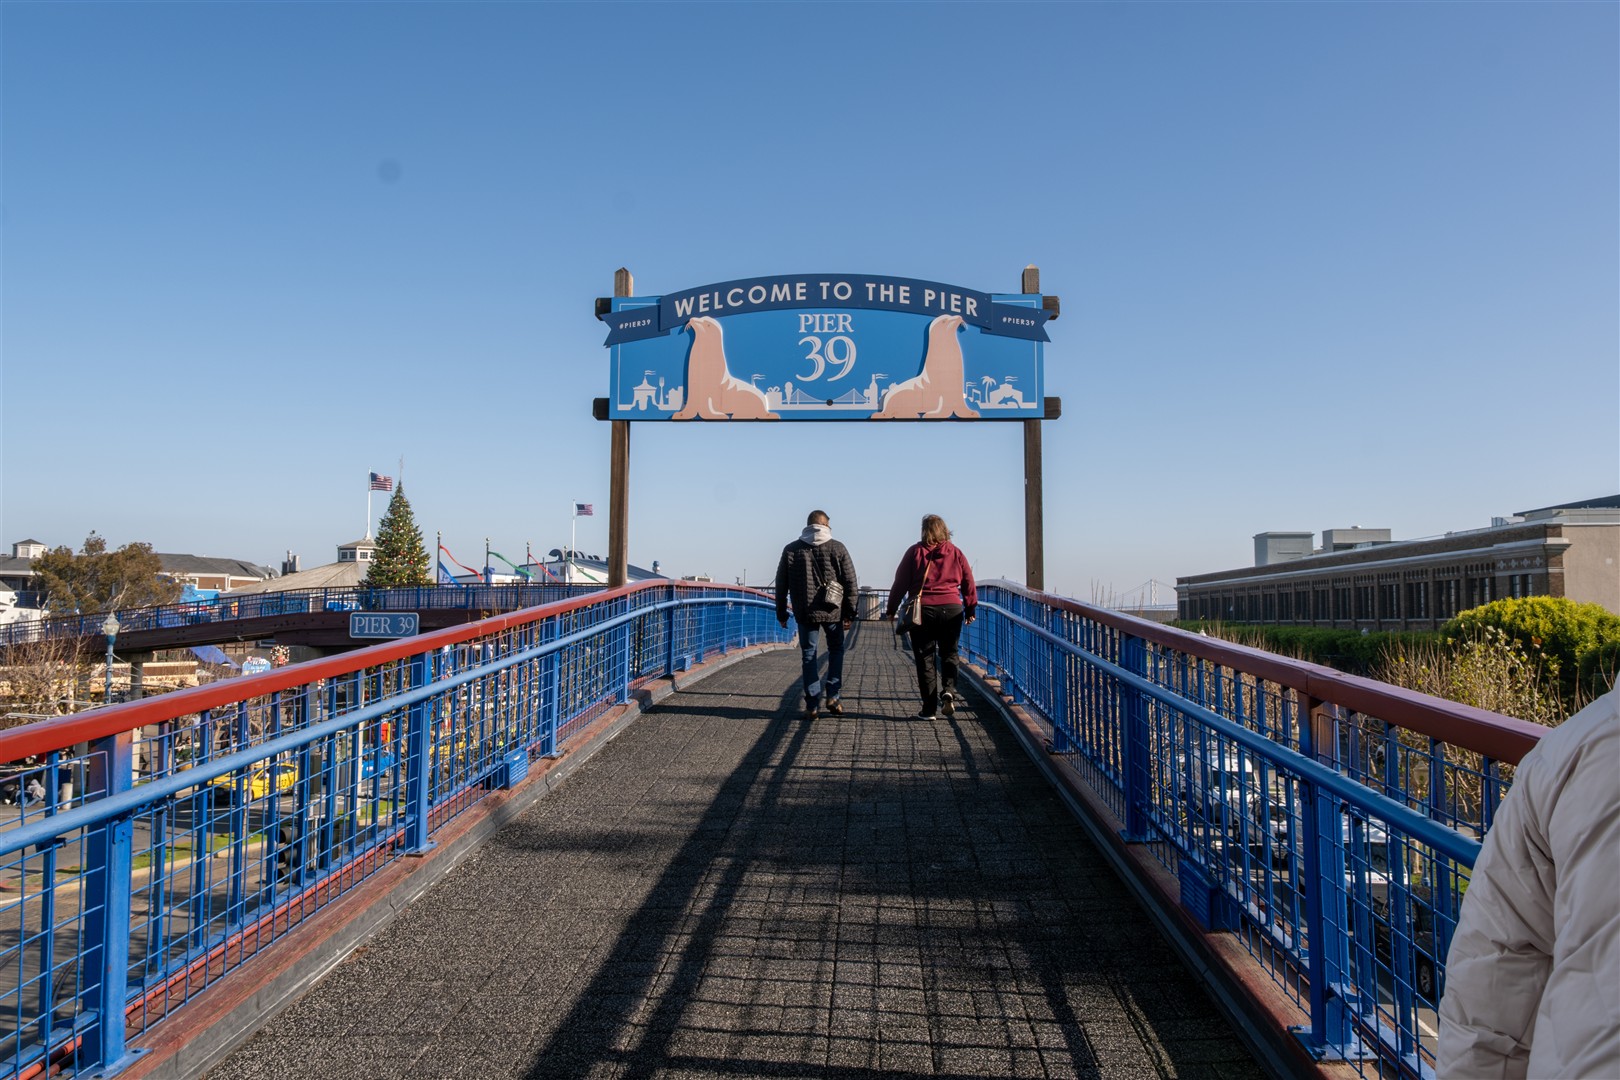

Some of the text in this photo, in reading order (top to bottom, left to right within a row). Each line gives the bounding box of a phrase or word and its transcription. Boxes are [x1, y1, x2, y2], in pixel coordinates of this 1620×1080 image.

[674, 281, 978, 318] WELCOME TO THE PIER
[798, 313, 855, 334] PIER
[795, 335, 857, 382] 39
[353, 616, 415, 635] PIER 39
